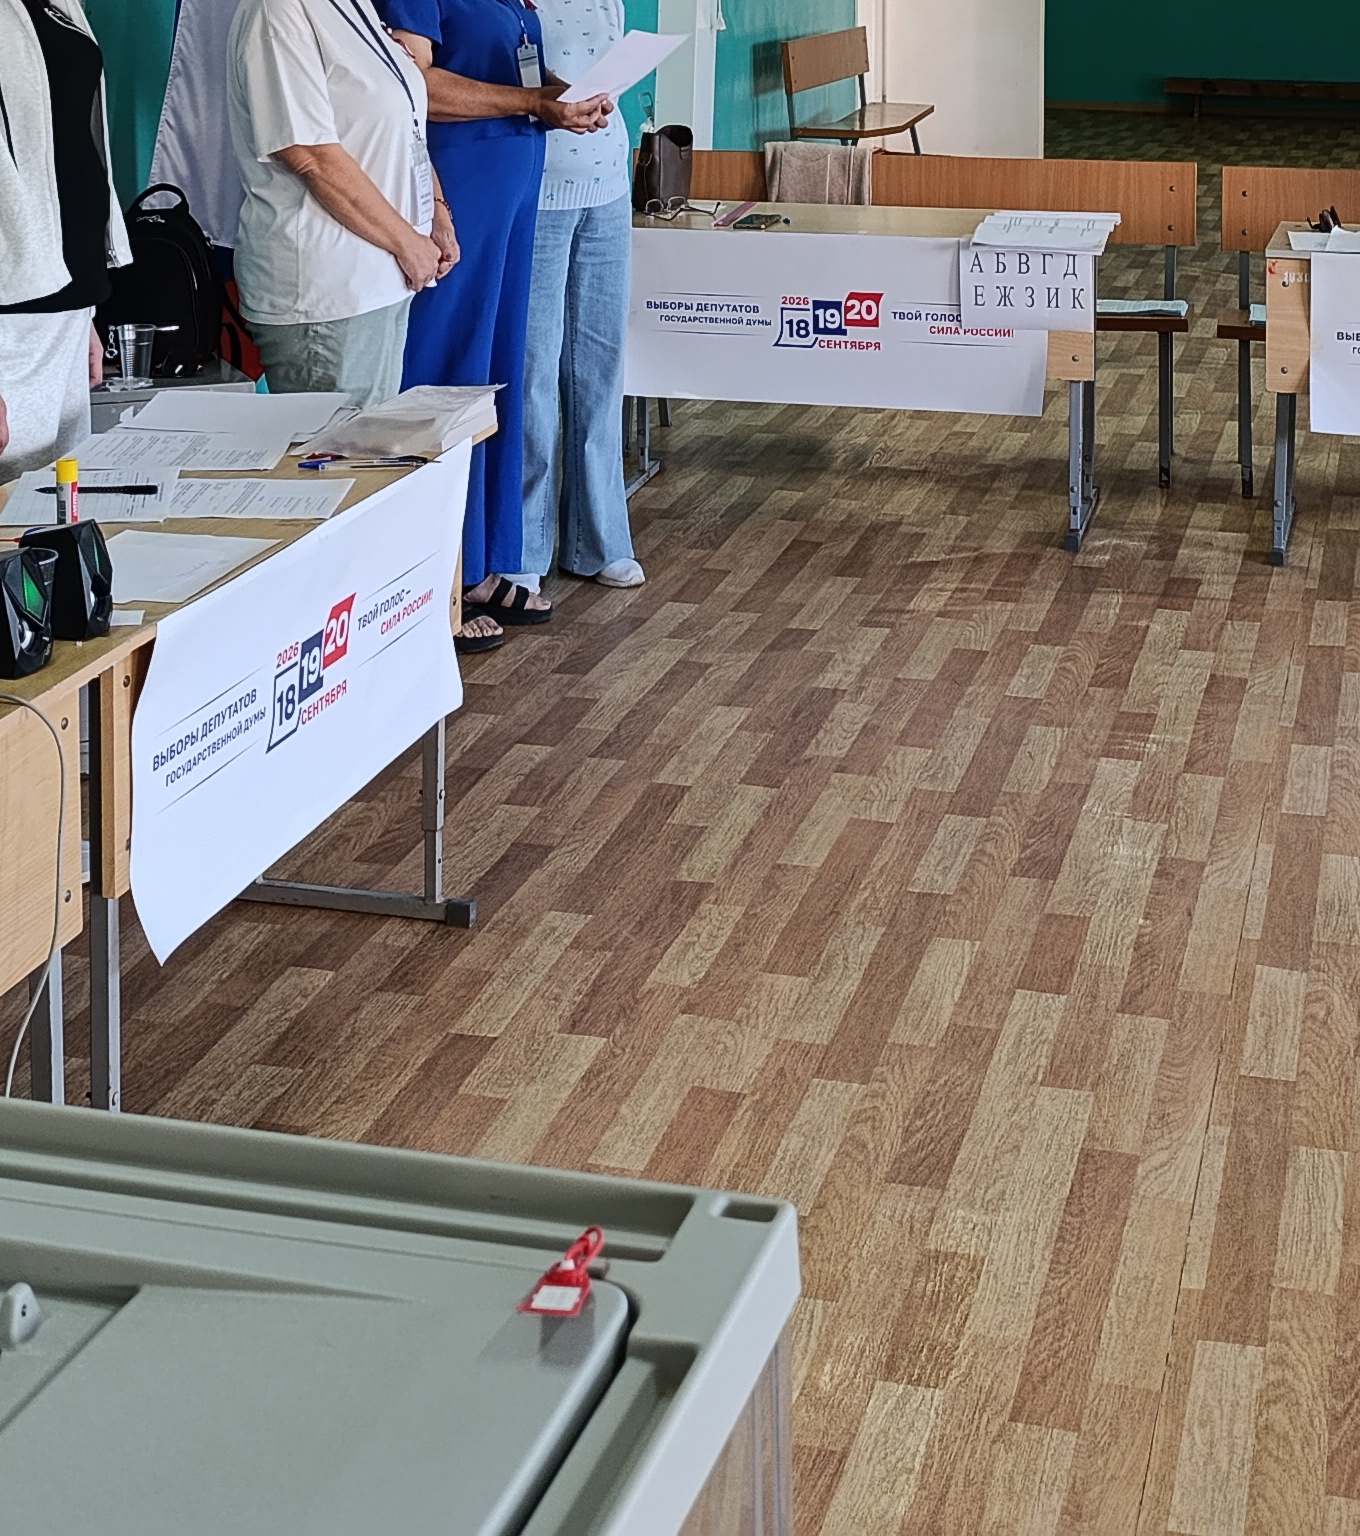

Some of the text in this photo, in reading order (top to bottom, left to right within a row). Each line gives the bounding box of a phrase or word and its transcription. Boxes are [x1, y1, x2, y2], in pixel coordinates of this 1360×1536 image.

[970, 251, 1078, 280] А Б В Г Д
[646, 300, 760, 314] ВЫБОРЫ ДЕПУТАТОВ
[781, 296, 810, 306] 2026
[974, 285, 1085, 309] Е Ж З И К
[660, 314, 772, 327] ГОСУДАРСТВЕННОЙ ДУМЫ
[785, 299, 878, 339] 18 19 20
[891, 309, 922, 323] ТВОЙ
[929, 326, 960, 335] СИЛА
[818, 339, 881, 351] СЕНТЯБРЯ
[357, 603, 379, 631] ТВОЙ
[379, 588, 405, 613] ГОЛОС
[380, 587, 434, 635] СИЛА РОССИИ!
[276, 641, 299, 669] 2026
[277, 610, 349, 726] 18 19 20
[301, 679, 347, 725] СЕНТЯБРЯ
[153, 688, 257, 772] ВЫБОРЫ ДЕПУТАТОВ
[165, 706, 267, 787] ГОСУДАРСТВЕННОЙ ДУМЫ
